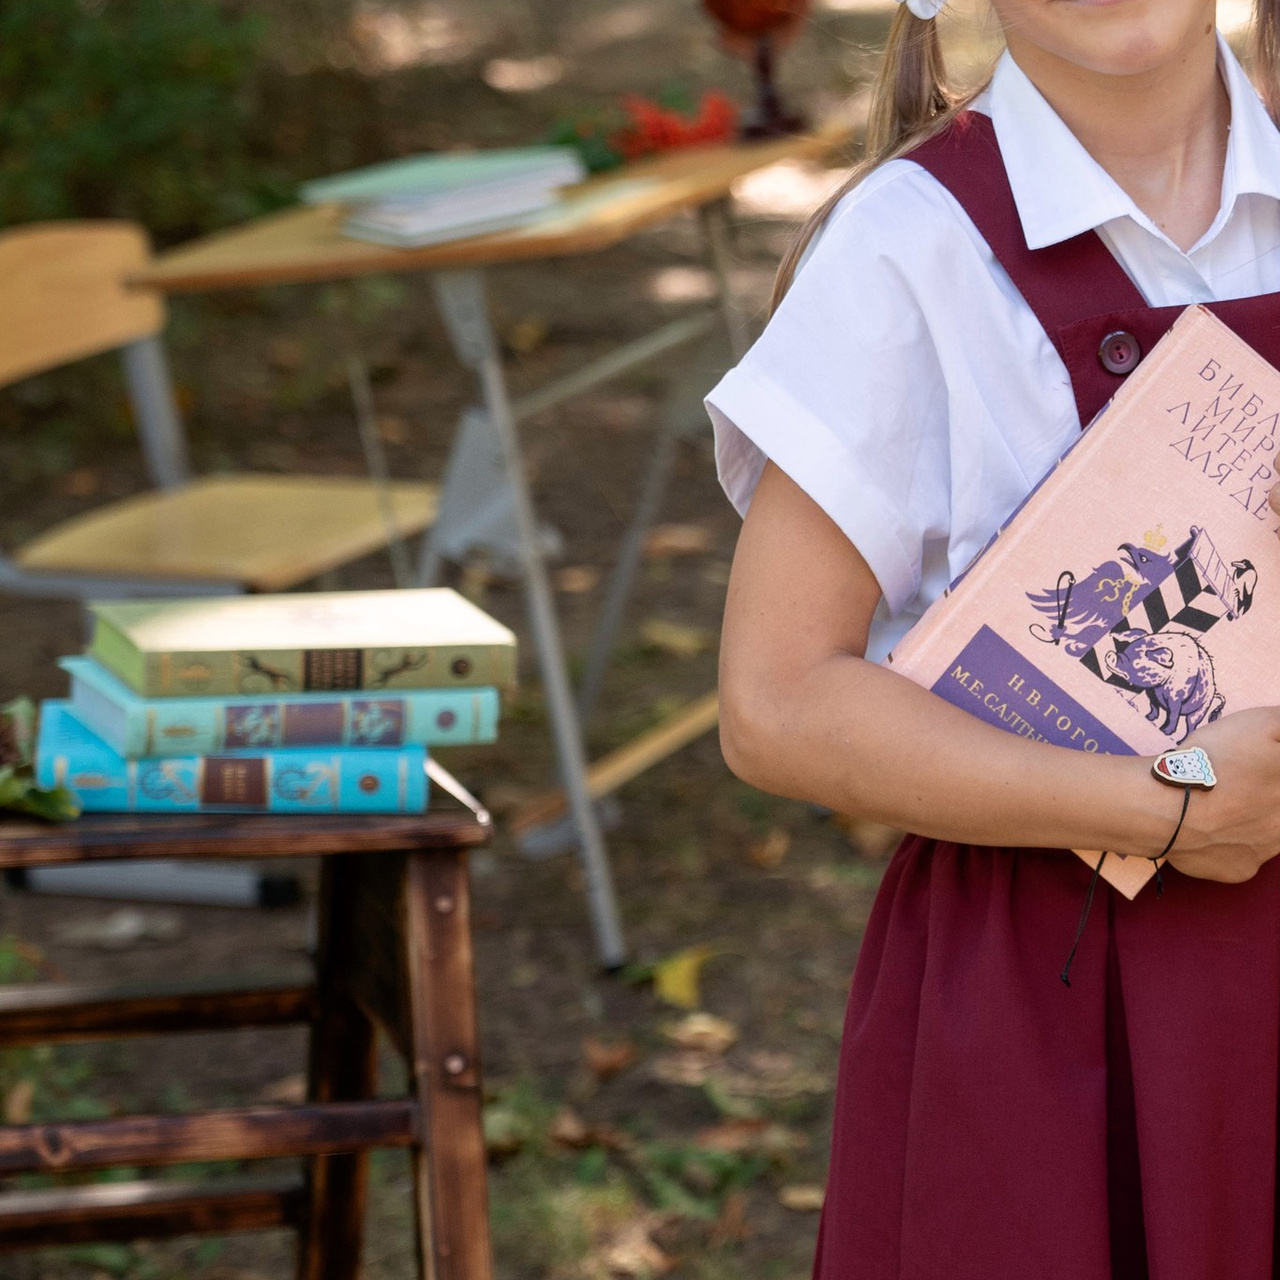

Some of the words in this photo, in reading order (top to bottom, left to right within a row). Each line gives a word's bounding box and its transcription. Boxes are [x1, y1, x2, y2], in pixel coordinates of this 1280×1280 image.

[1166, 401, 1272, 494] ЛИТЕР
[1205, 395, 1278, 466] МИР
[1169, 436, 1233, 486] ДЛЯ
[1229, 486, 1279, 535] ДЕ
[1043, 704, 1112, 755] ГОГО
